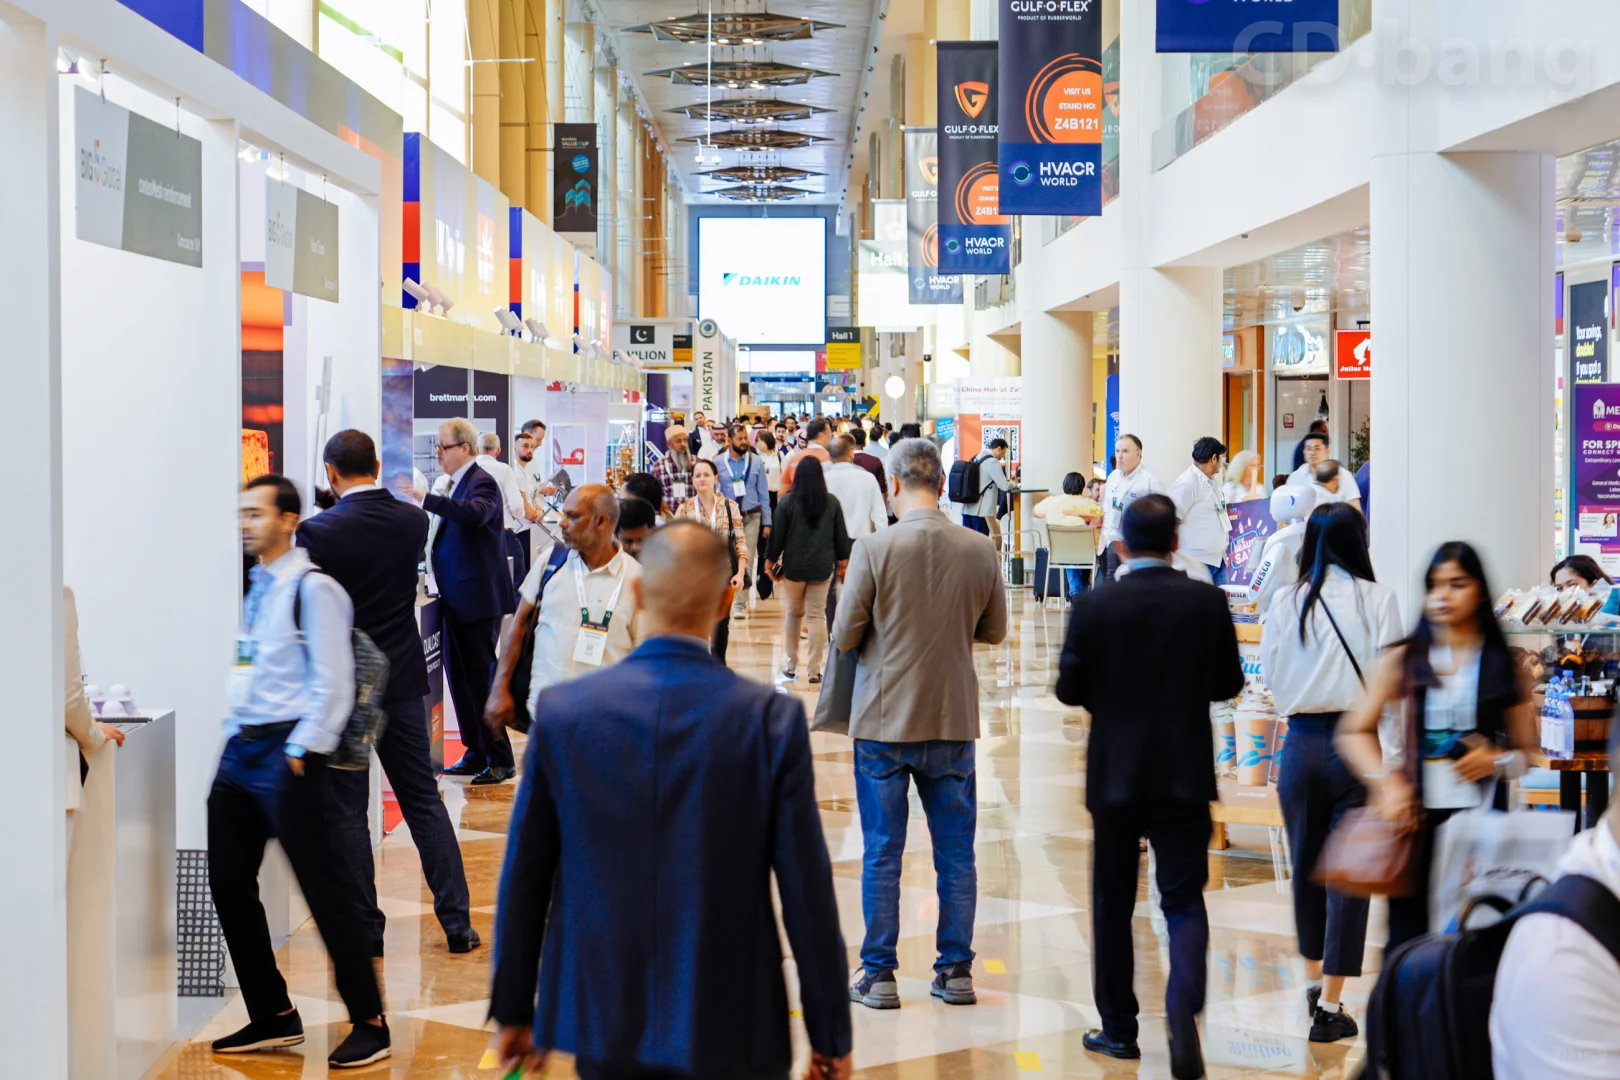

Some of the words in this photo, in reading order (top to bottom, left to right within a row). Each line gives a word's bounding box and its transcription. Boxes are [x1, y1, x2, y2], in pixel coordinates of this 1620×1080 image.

[1063, 87, 1080, 95] VISIT
[1082, 87, 1092, 95] US
[1058, 102, 1082, 110] STAND
[1083, 102, 1096, 110] NO:
[1054, 117, 1099, 130] Z4B121
[1040, 162, 1095, 176] HVACR
[1040, 177, 1078, 186] WORLD
[965, 238, 1004, 248] HVACR
[870, 252, 902, 267] Hall
[740, 275, 801, 286] DAIKIN
[929, 276, 960, 284] HVACR
[832, 332, 846, 340] Hall
[848, 332, 853, 340] 1
[1576, 326, 1586, 341] Your
[1576, 341, 1595, 358] doubled
[703, 351, 713, 411] PAKISTAN
[1583, 440, 1603, 449] FOR
[1255, 560, 1271, 586] DESCO
